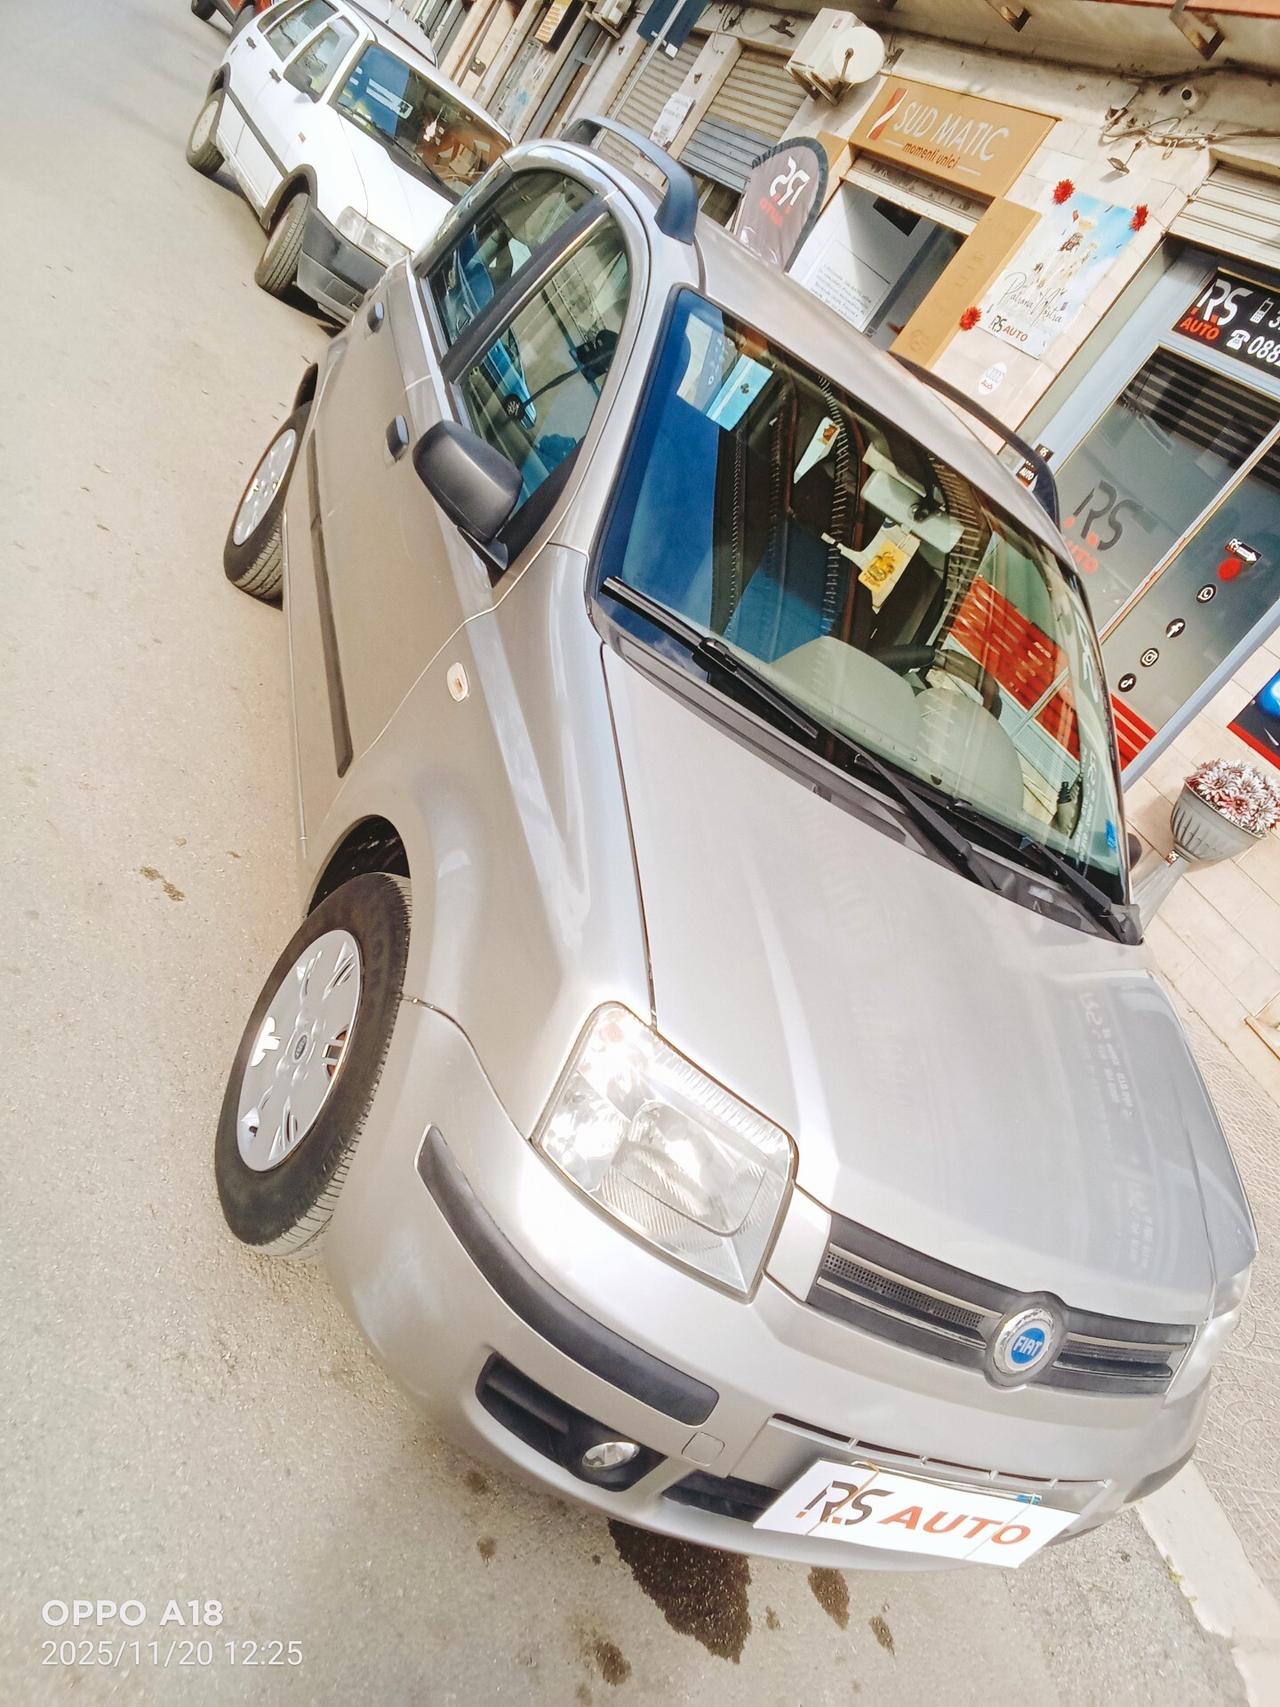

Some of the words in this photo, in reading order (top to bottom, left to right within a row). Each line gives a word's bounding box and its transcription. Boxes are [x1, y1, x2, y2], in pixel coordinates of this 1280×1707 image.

[894, 100, 938, 138] SUD
[931, 113, 1010, 161] MATIC
[903, 142, 939, 163] momenti
[937, 152, 961, 170] unici
[1191, 279, 1254, 326] RS
[988, 314, 1008, 333] RS
[1002, 325, 1029, 342] AUTO
[1180, 316, 1220, 340] AUTO
[1247, 336, 1280, 367] 088
[1018, 466, 1035, 481] AUTO
[1064, 480, 1144, 551] RS
[1013, 1335, 1043, 1357] FIAT
[796, 1480, 895, 1526] RS
[876, 1505, 1032, 1546] AUTO
